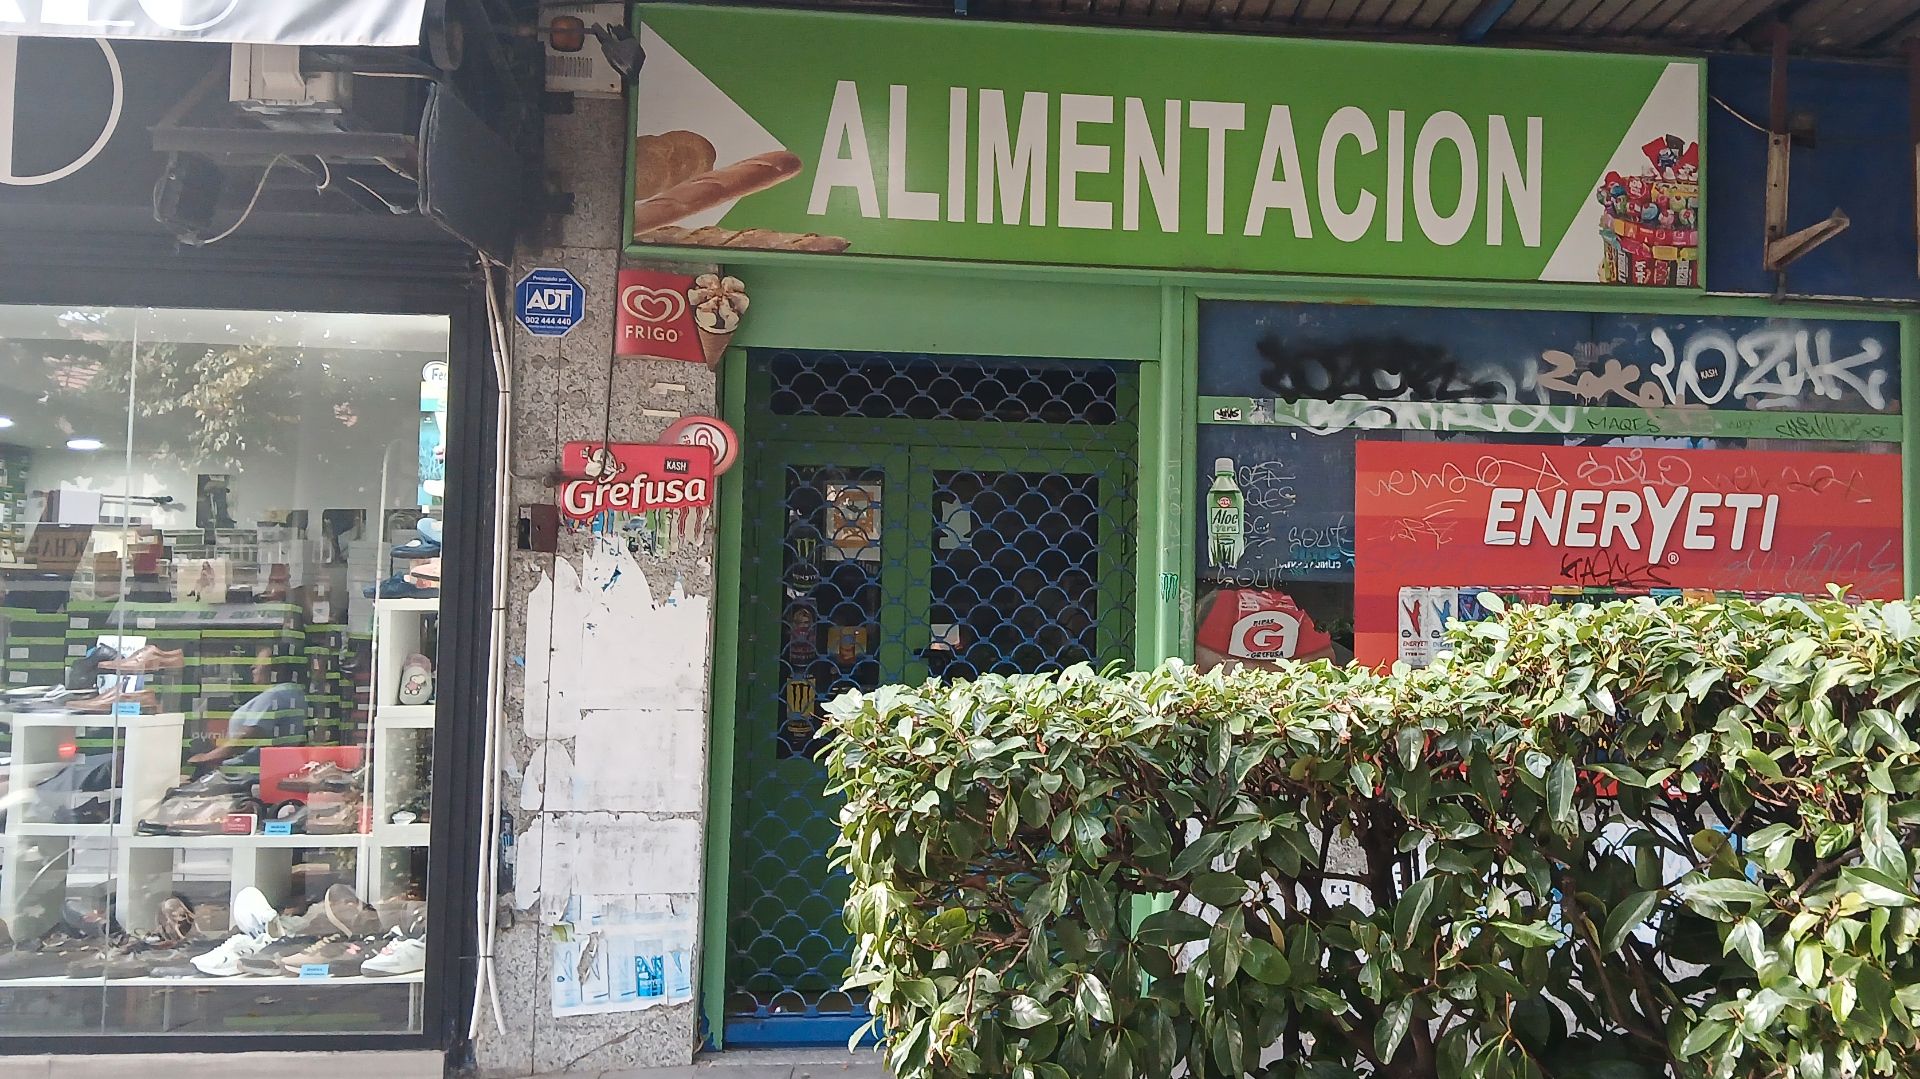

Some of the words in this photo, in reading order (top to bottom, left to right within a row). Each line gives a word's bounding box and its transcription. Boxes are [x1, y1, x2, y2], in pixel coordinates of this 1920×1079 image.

[806, 79, 1543, 248] ALIMENTACION
[527, 288, 572, 311] ADT
[541, 317, 556, 325] 444
[556, 318, 572, 326] 440
[624, 324, 679, 343] FRIGO
[1700, 368, 1719, 380] KASH
[665, 460, 687, 471] KASH
[564, 474, 706, 515] Grefusa
[1213, 509, 1239, 524] Aloe
[1484, 486, 1779, 565] ENERYETI
